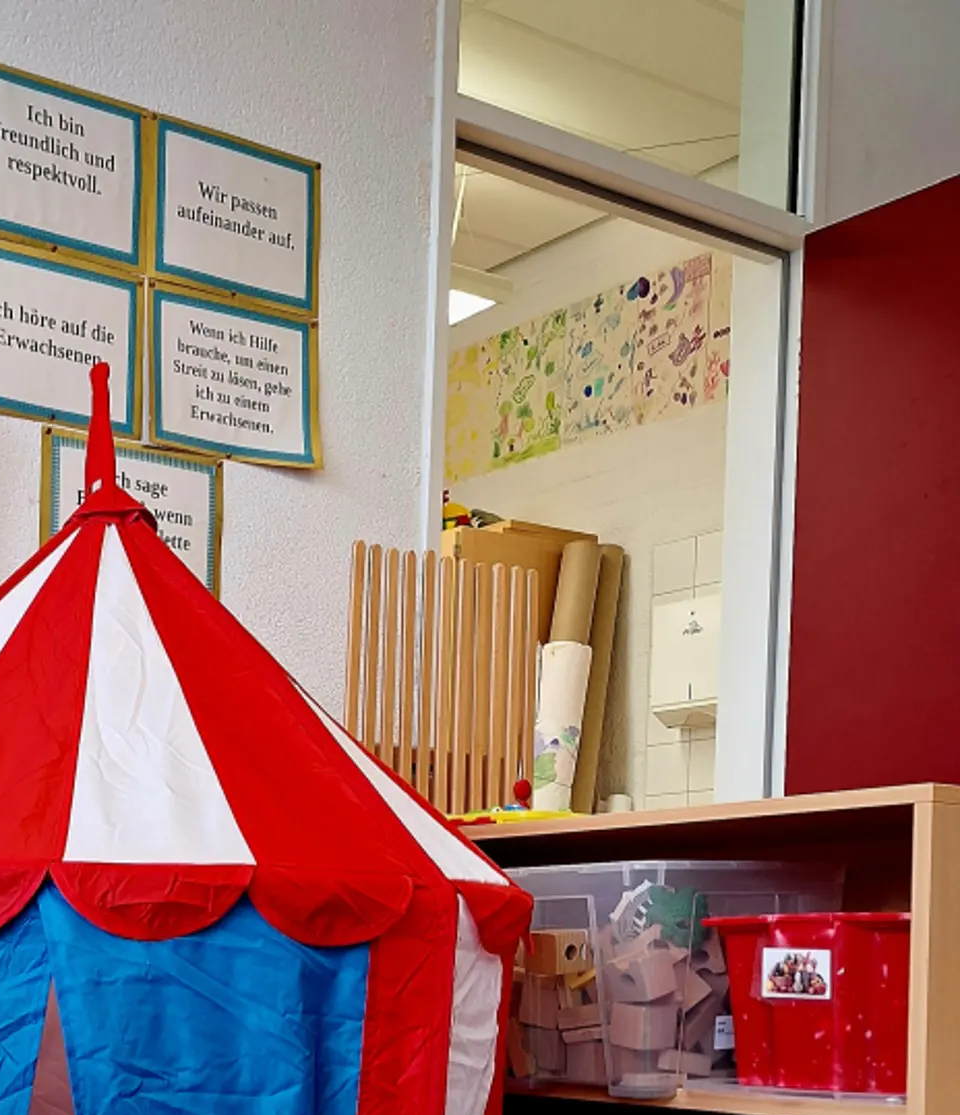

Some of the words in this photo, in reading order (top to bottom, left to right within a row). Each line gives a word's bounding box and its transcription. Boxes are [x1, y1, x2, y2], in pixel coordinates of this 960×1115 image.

[27, 104, 53, 127] Ich
[59, 113, 85, 137] bin
[7, 156, 102, 195] respektvoll.
[84, 154, 115, 172] und
[198, 181, 228, 204] Wir
[231, 195, 278, 220] passen
[177, 204, 265, 241] aufeinander
[268, 233, 295, 250] auf.
[19, 305, 57, 330] höre
[61, 320, 87, 338] auf
[91, 324, 115, 345] die
[189, 320, 225, 341] Wenn
[228, 328, 247, 346] ich
[249, 334, 279, 354] Hilfe
[177, 337, 231, 365] brauche,
[235, 355, 253, 369] um
[256, 358, 289, 376] einen
[173, 359, 208, 380] Streit
[210, 370, 225, 383] zu
[228, 370, 262, 393] lösen,
[264, 381, 292, 398] gehe
[195, 384, 214, 400] ich
[217, 392, 231, 405] zu
[234, 395, 270, 413] einem
[190, 405, 274, 434] Erwachsenen.
[134, 479, 168, 499] sage
[155, 508, 193, 526] wenn
[159, 529, 191, 551] lette
